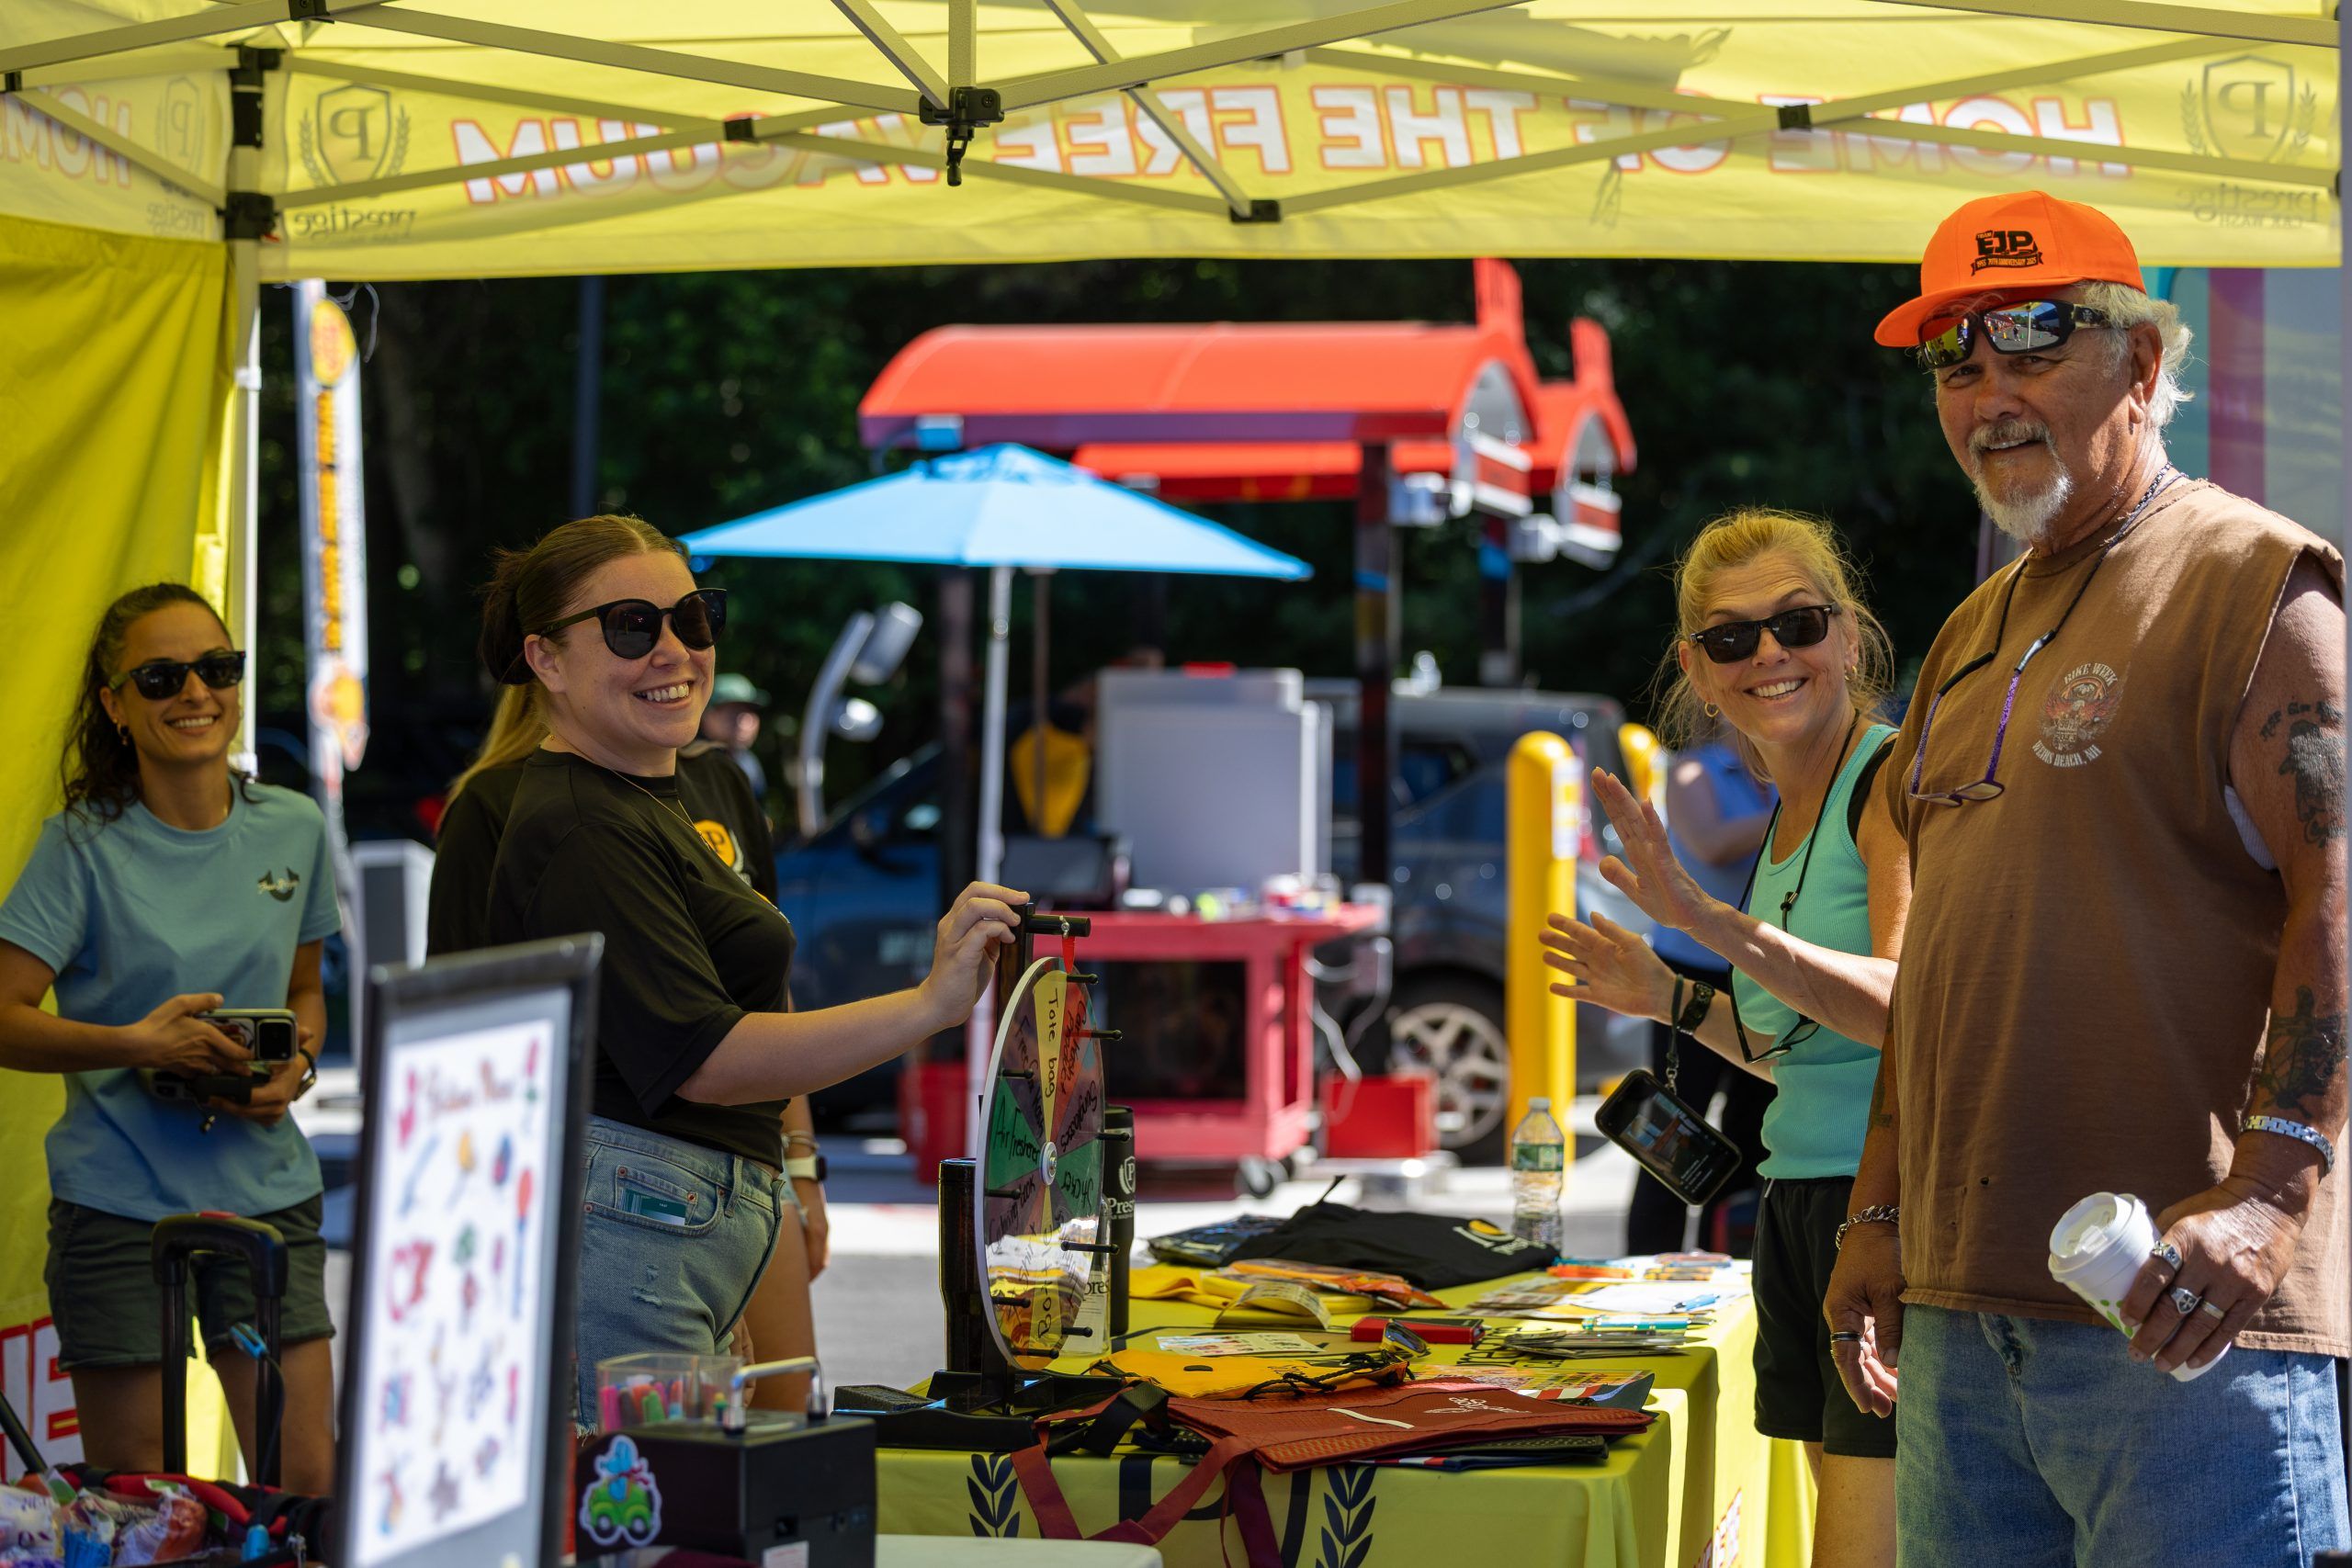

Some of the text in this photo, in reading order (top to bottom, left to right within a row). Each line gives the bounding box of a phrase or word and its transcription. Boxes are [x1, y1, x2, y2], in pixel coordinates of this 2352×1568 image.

[1976, 230, 2034, 255] EJP
[2092, 662, 2118, 687] WEEK
[2084, 744, 2102, 761] NH
[1046, 987, 1059, 1098] Tote bag
